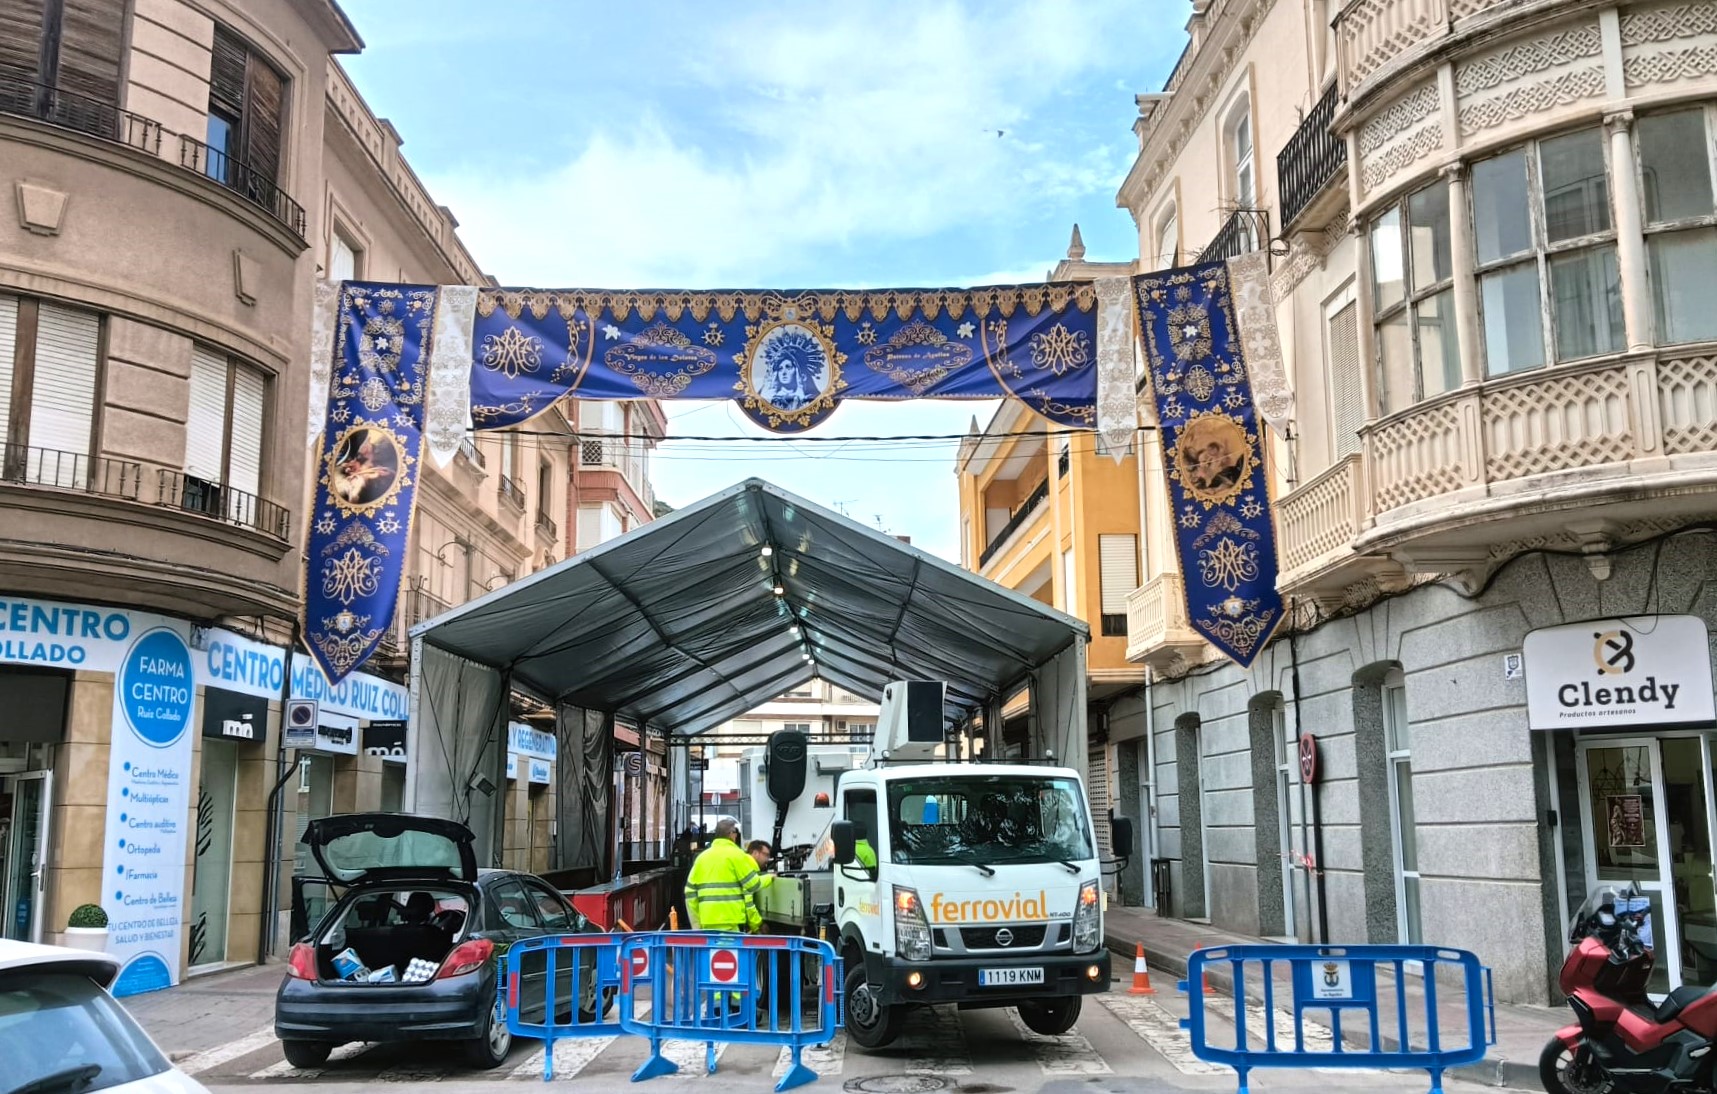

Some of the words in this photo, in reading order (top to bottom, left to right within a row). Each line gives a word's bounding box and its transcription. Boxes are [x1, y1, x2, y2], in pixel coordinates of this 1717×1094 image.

[0, 639, 87, 664] LLADO
[139, 656, 185, 679] FARMA
[207, 641, 283, 692] CENTRO
[350, 679, 378, 712] RUIZ
[132, 682, 188, 705] CENTRO
[1558, 676, 1680, 710] Clendy
[137, 705, 155, 719] Ruiz
[155, 707, 182, 722] Collado
[1559, 709, 1596, 719] Productos
[1598, 708, 1637, 717] artesanos
[131, 766, 156, 779] Centro
[128, 817, 153, 829] Centro
[124, 894, 149, 906] Centro
[149, 892, 157, 904] de
[930, 889, 1049, 924] ferrovial
[117, 920, 147, 931] CENTRO
[147, 918, 156, 929] DE
[115, 933, 139, 945] SALUD
[988, 970, 1016, 983] 1119
[1019, 969, 1041, 982] KNM
